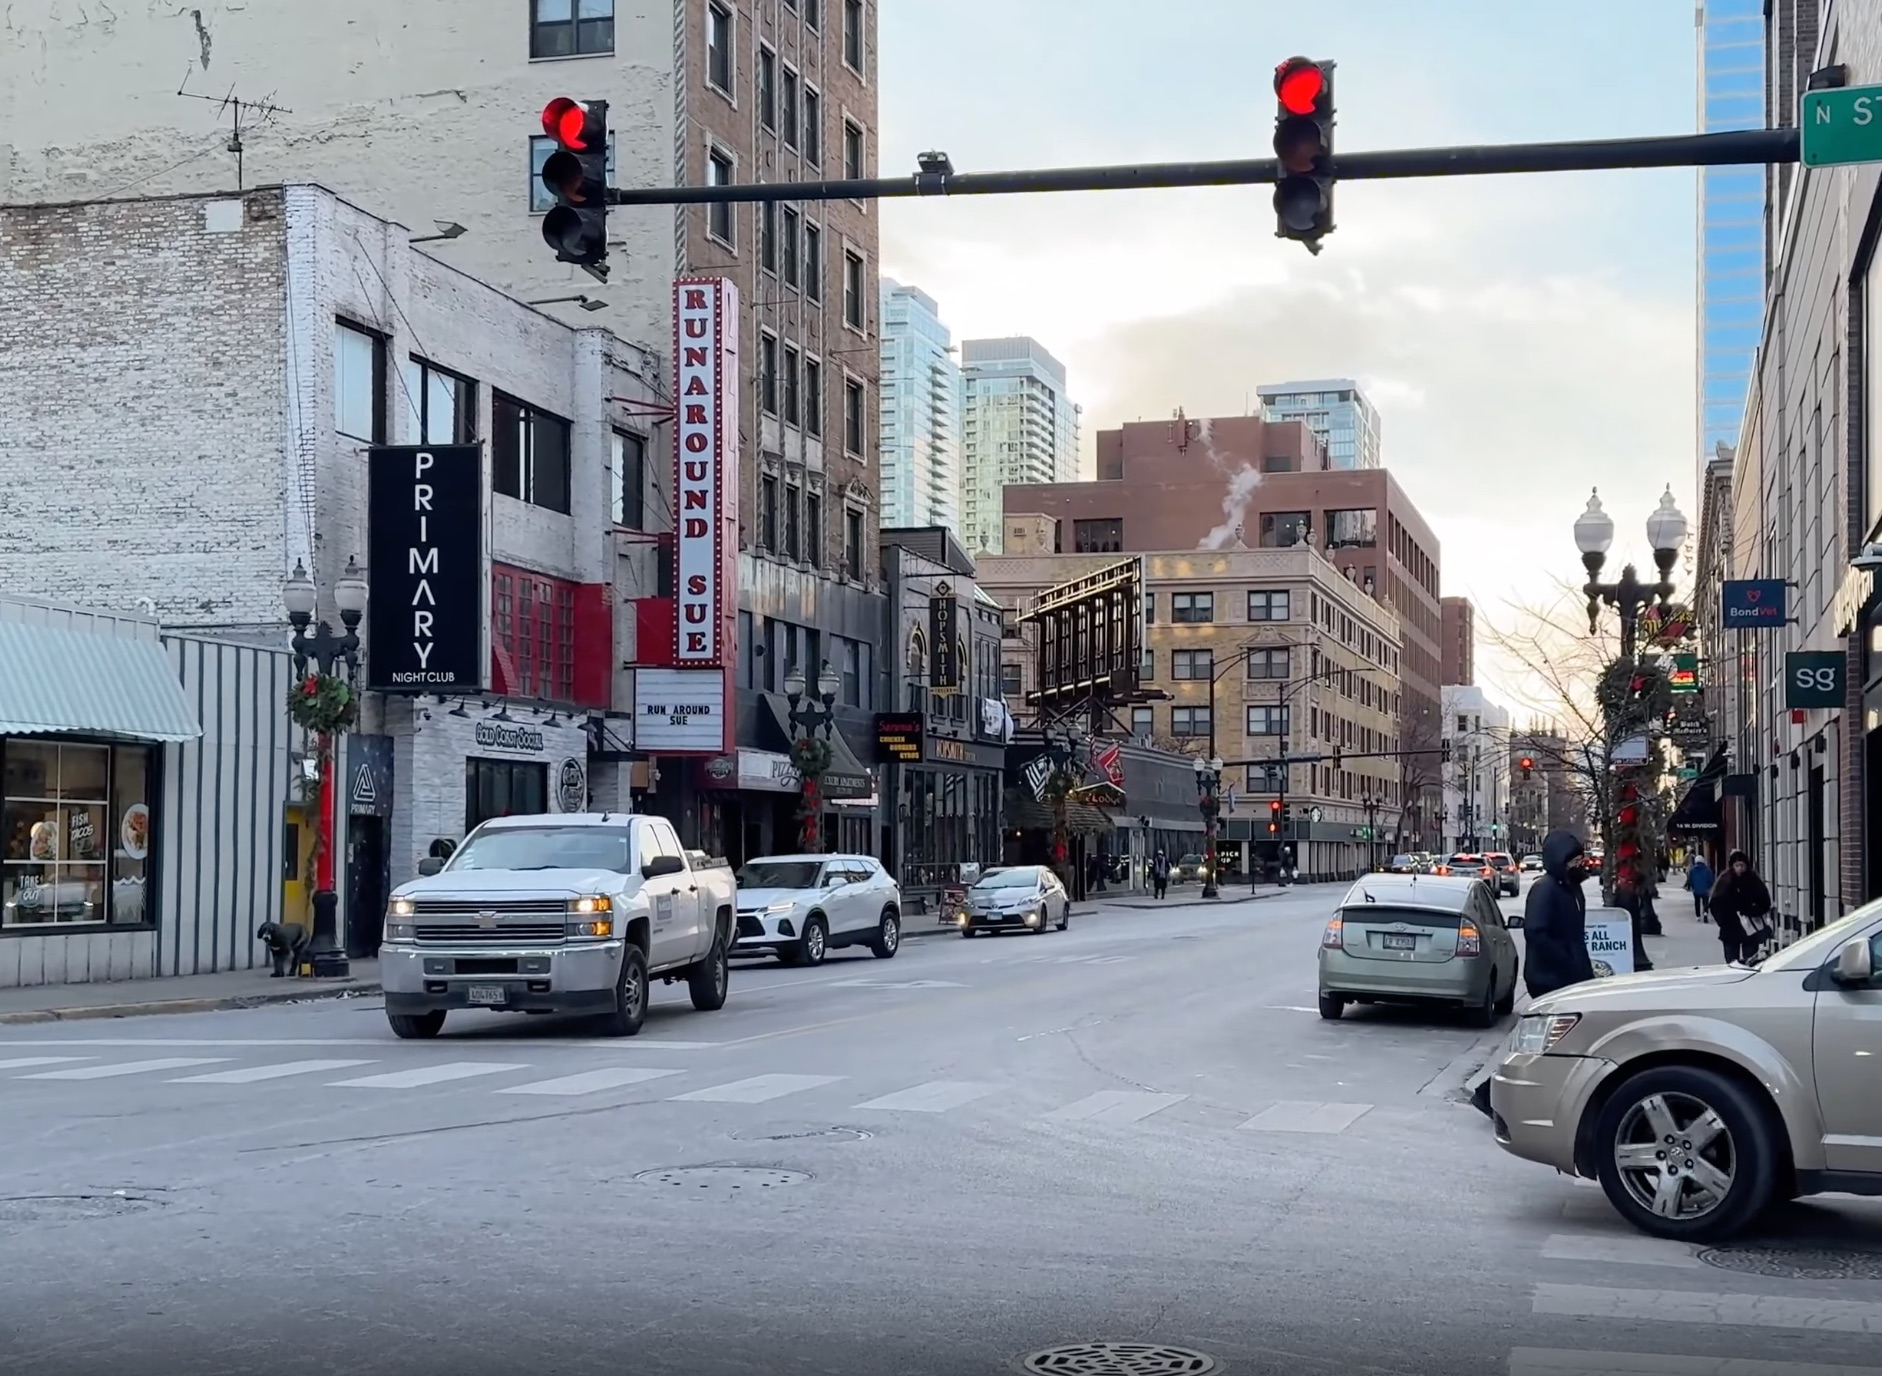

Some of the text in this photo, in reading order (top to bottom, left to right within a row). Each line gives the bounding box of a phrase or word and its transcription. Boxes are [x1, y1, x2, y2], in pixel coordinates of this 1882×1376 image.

[1817, 105, 1830, 124] N
[684, 288, 708, 653] RUNAROUND SUE
[409, 452, 439, 669] PRIMARY
[937, 599, 949, 686] HOPSMITH
[1796, 667, 1836, 691] sg
[647, 705, 710, 715] RUN AROUND
[670, 715, 688, 725] SUE
[476, 722, 544, 751] GOLD COAST SOCIAL
[71, 812, 89, 827] FISH
[71, 825, 94, 841] TACOS
[23, 888, 41, 901] OUT
[1592, 931, 1610, 941] ALL
[1592, 941, 1627, 952] RANCH
